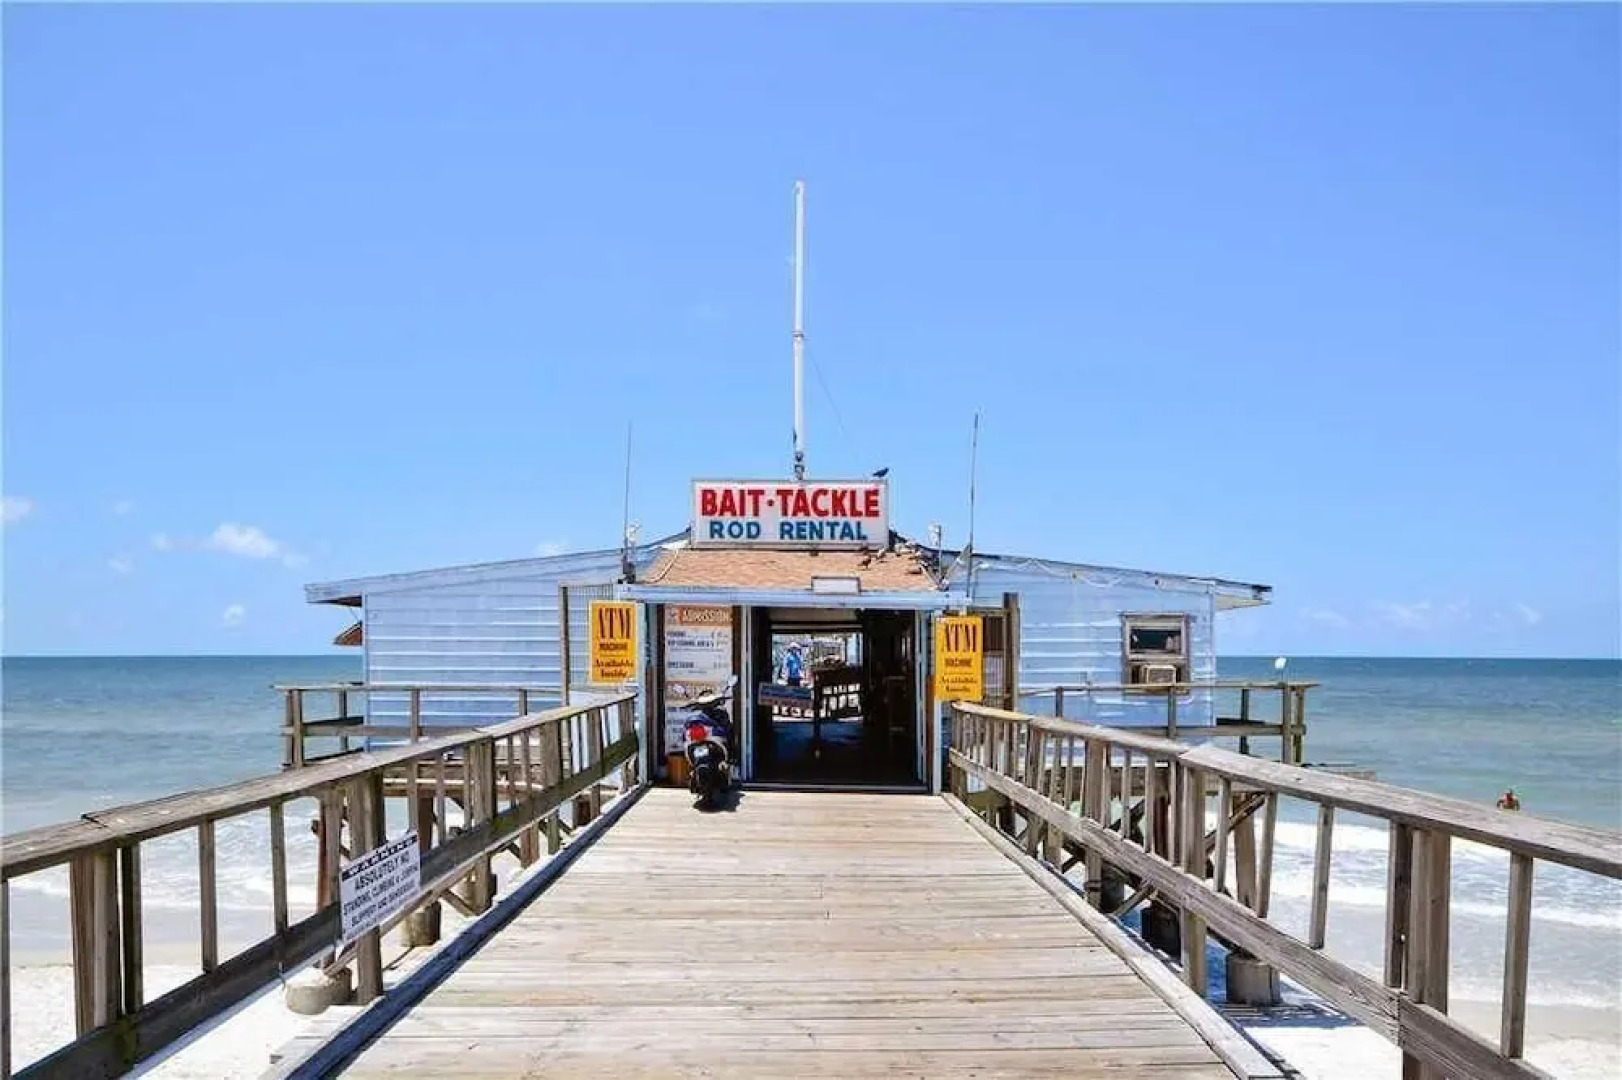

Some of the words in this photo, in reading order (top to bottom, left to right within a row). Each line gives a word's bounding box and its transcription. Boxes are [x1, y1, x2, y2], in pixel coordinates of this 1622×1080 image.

[776, 489, 880, 517] TACKLE
[709, 520, 761, 539] ROD
[779, 520, 868, 540] RENTAL
[596, 607, 635, 639] ATM
[941, 623, 977, 653] ATM
[355, 857, 398, 890] ABSOLUTELY
